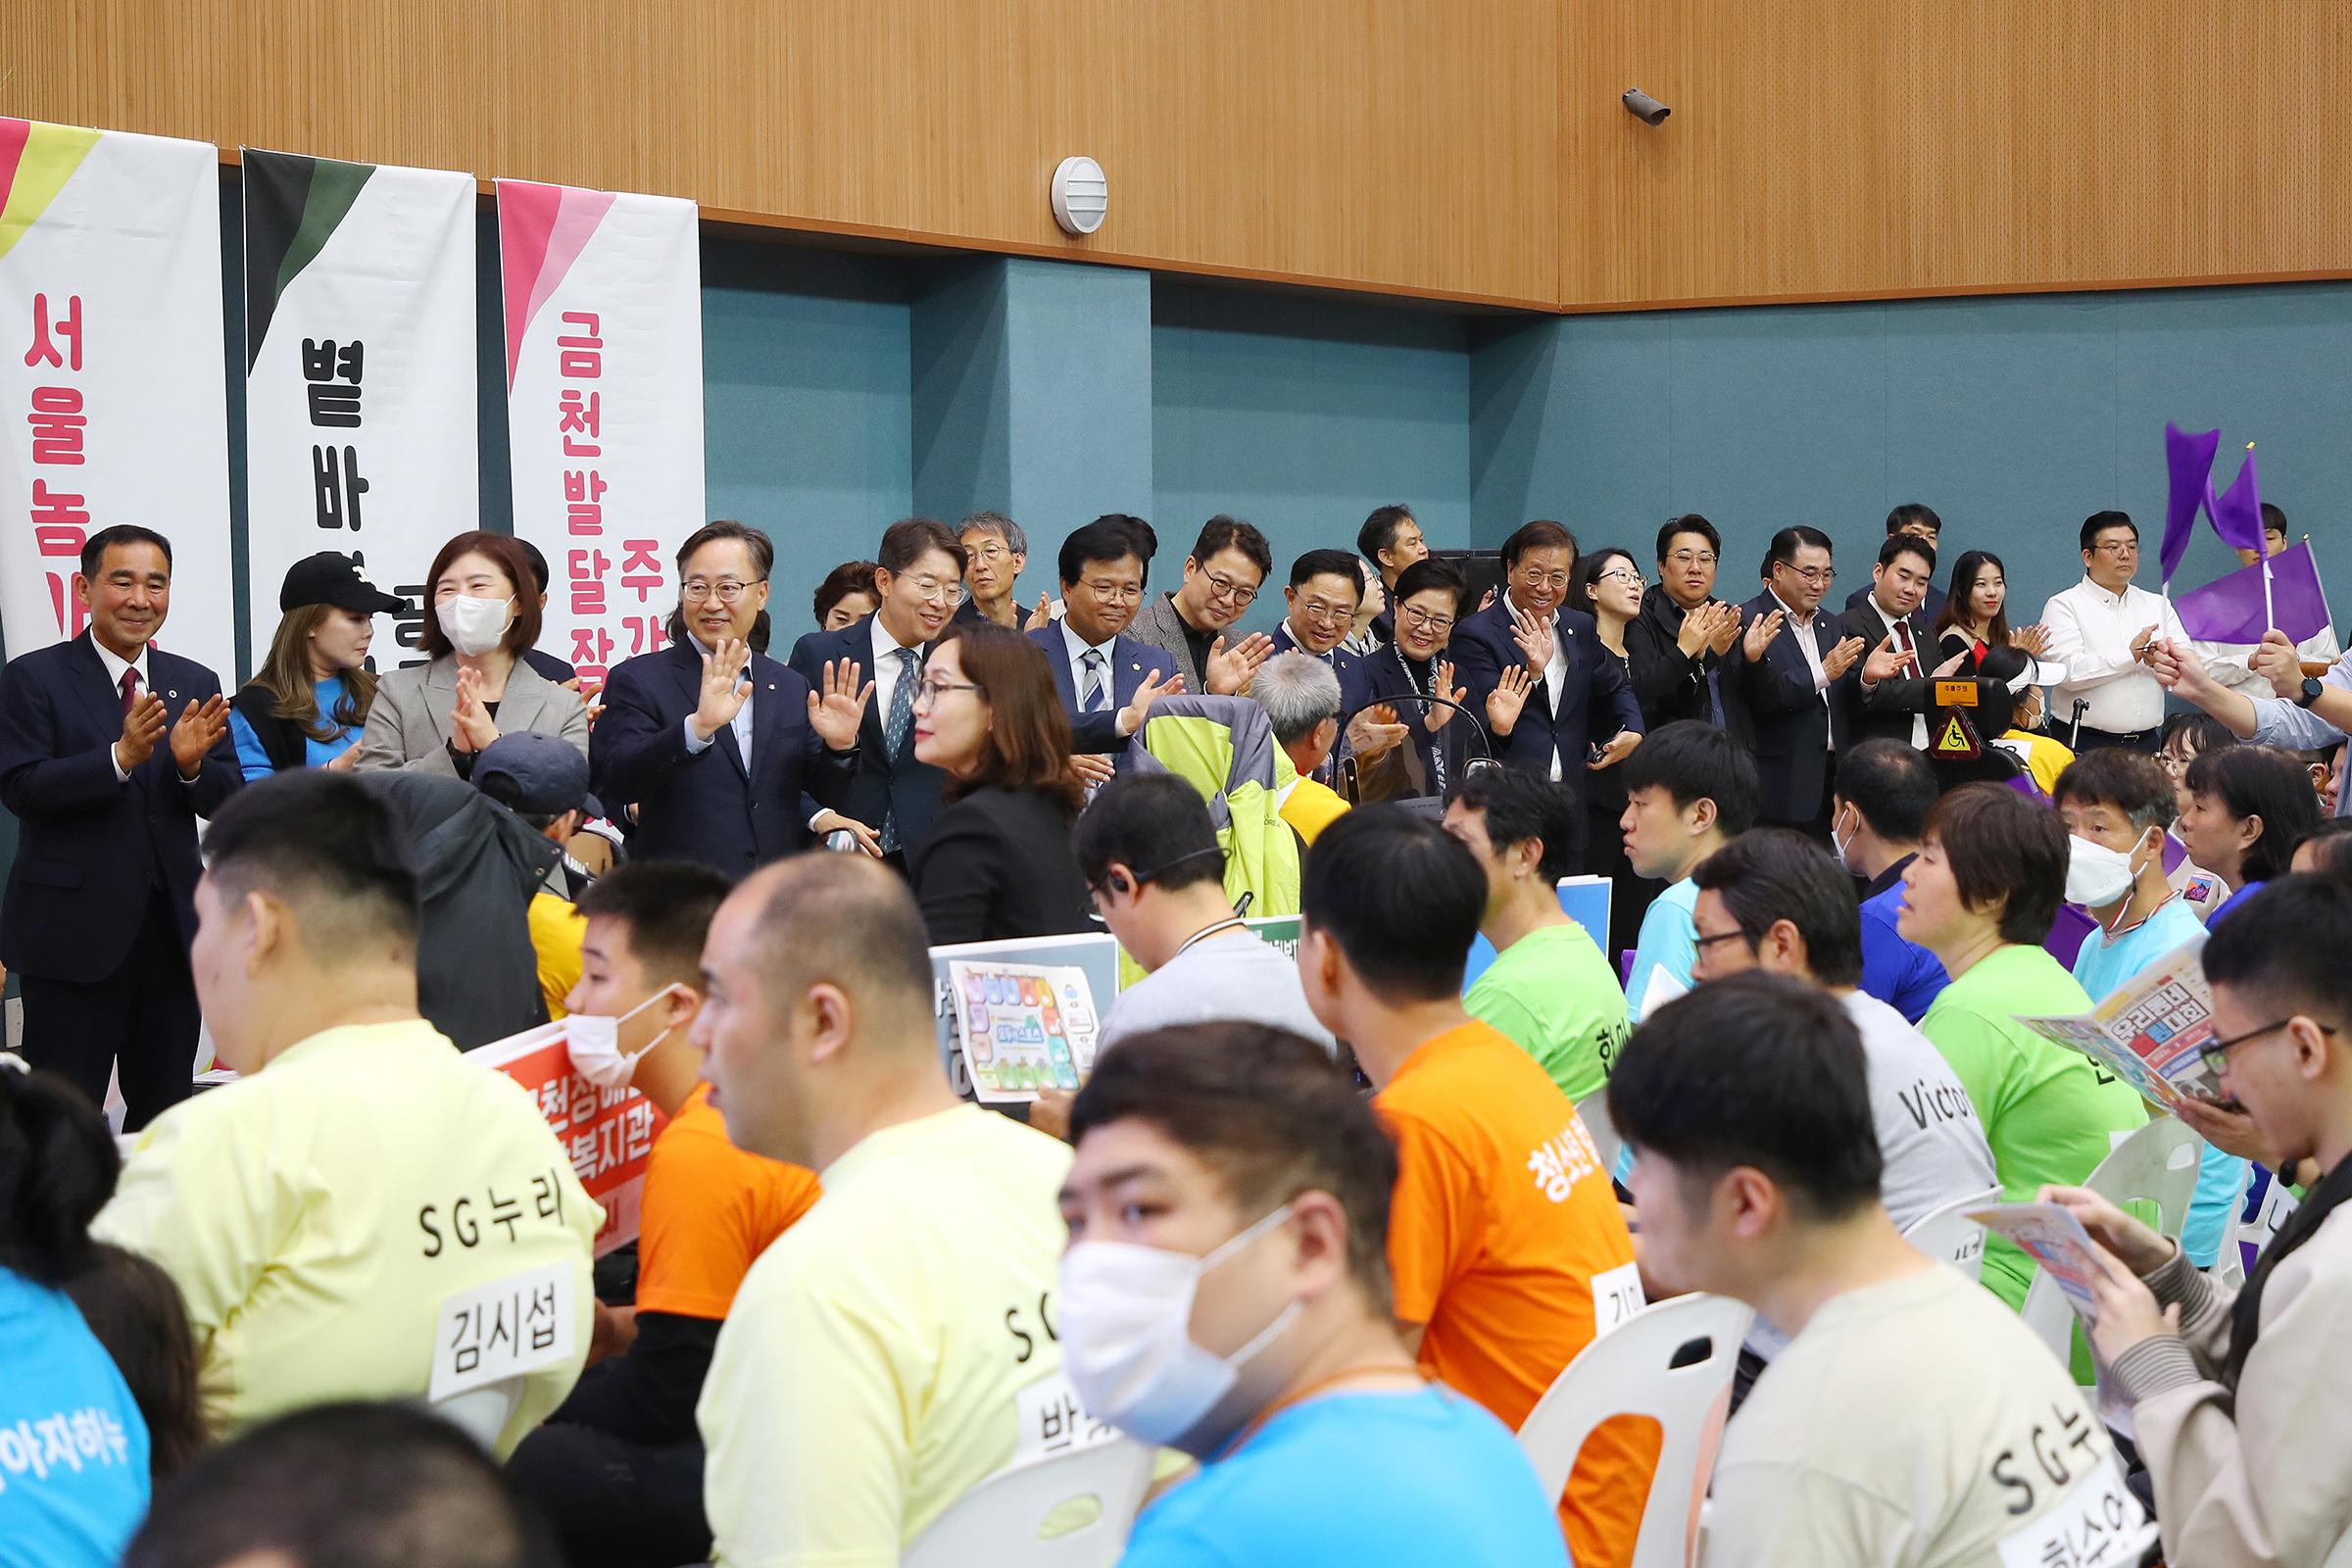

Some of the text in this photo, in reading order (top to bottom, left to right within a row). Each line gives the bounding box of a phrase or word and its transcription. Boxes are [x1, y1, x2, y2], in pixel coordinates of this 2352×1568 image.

[302, 337, 370, 566] 볕바
[561, 1100, 656, 1180] 복지관
[418, 1167, 564, 1258] SG누리
[451, 1282, 556, 1375] 김시섭
